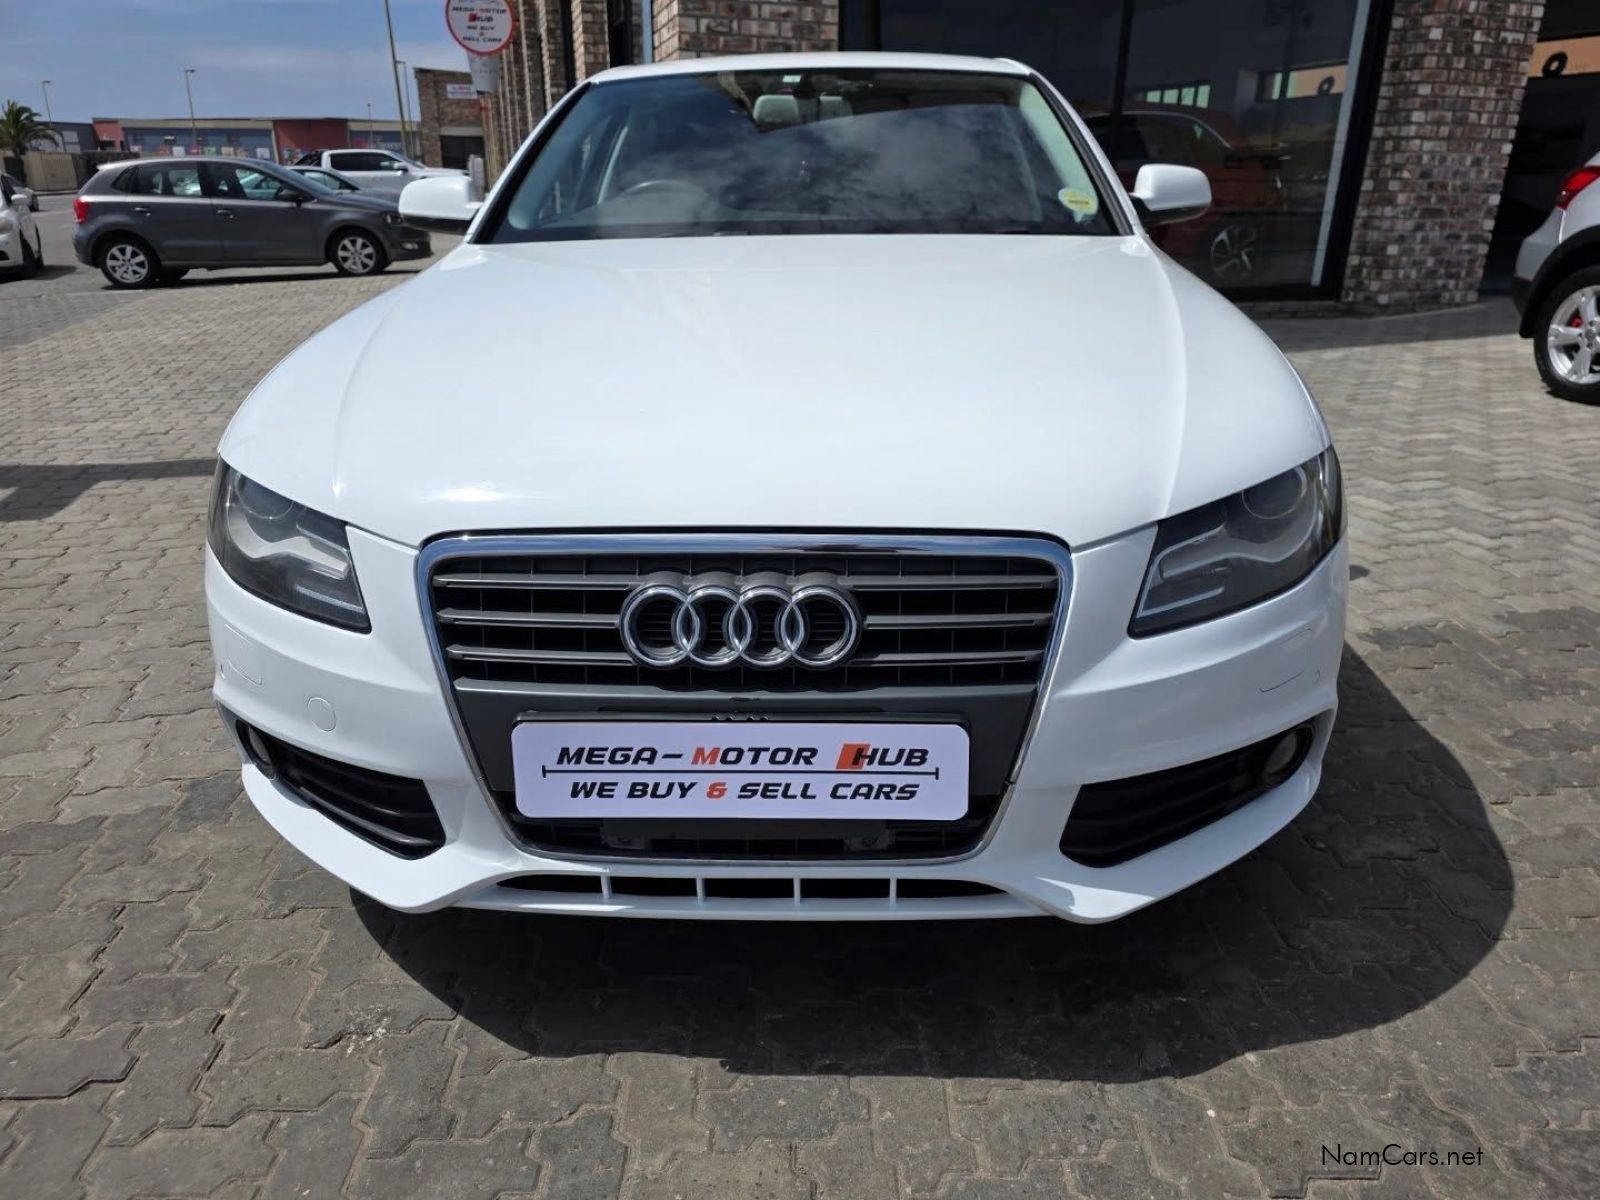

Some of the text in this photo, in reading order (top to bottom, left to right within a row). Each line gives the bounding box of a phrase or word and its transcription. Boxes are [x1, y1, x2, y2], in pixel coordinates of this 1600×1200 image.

[690, 746, 819, 766] MOTOR
[850, 747, 929, 767] HUB
[570, 781, 921, 801] WE BUY & SELL CARS
